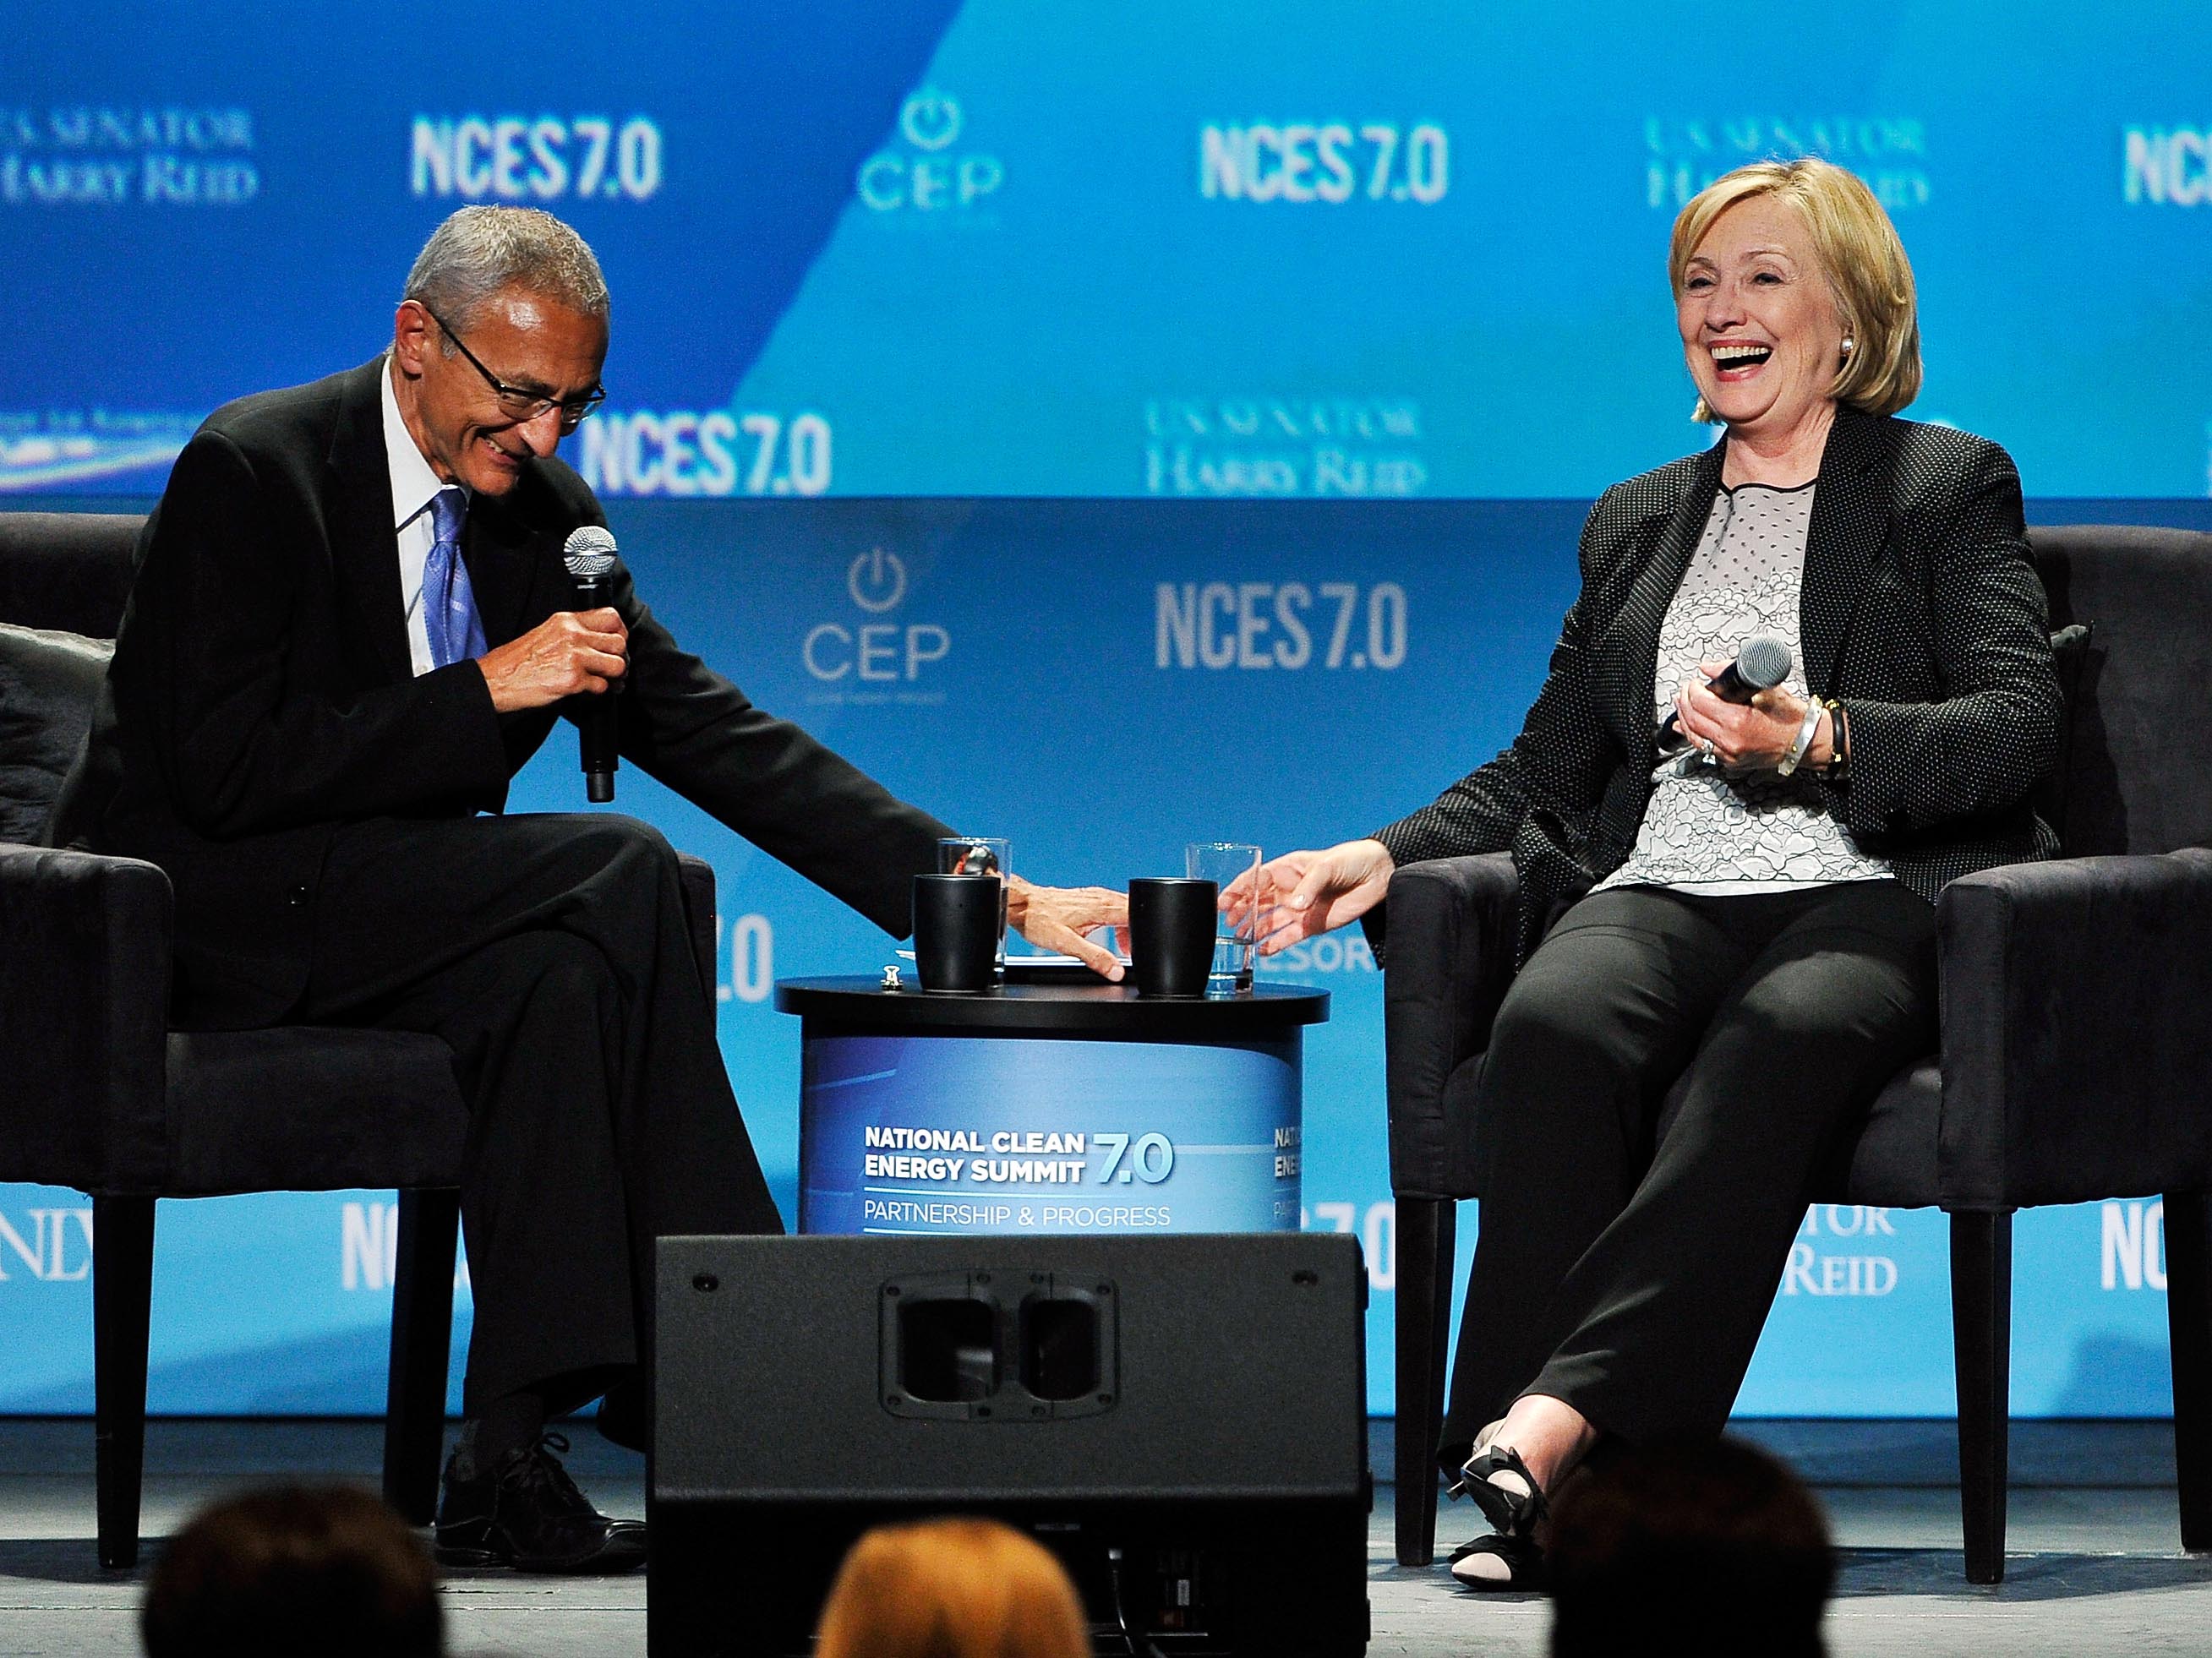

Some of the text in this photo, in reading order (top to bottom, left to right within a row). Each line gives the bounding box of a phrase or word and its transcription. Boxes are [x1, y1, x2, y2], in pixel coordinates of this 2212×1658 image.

[857, 152, 1003, 211] CEP
[804, 623, 952, 680] CEP
[865, 1126, 1084, 1154] NATIONAL CLEAN
[1093, 1132, 1174, 1184] 7.0
[865, 1154, 1085, 1184] ENERGY SUMMIT
[864, 1199, 1171, 1226] PARTNERSHIP & PROGRESS
[1783, 1241, 1898, 1296] REID
